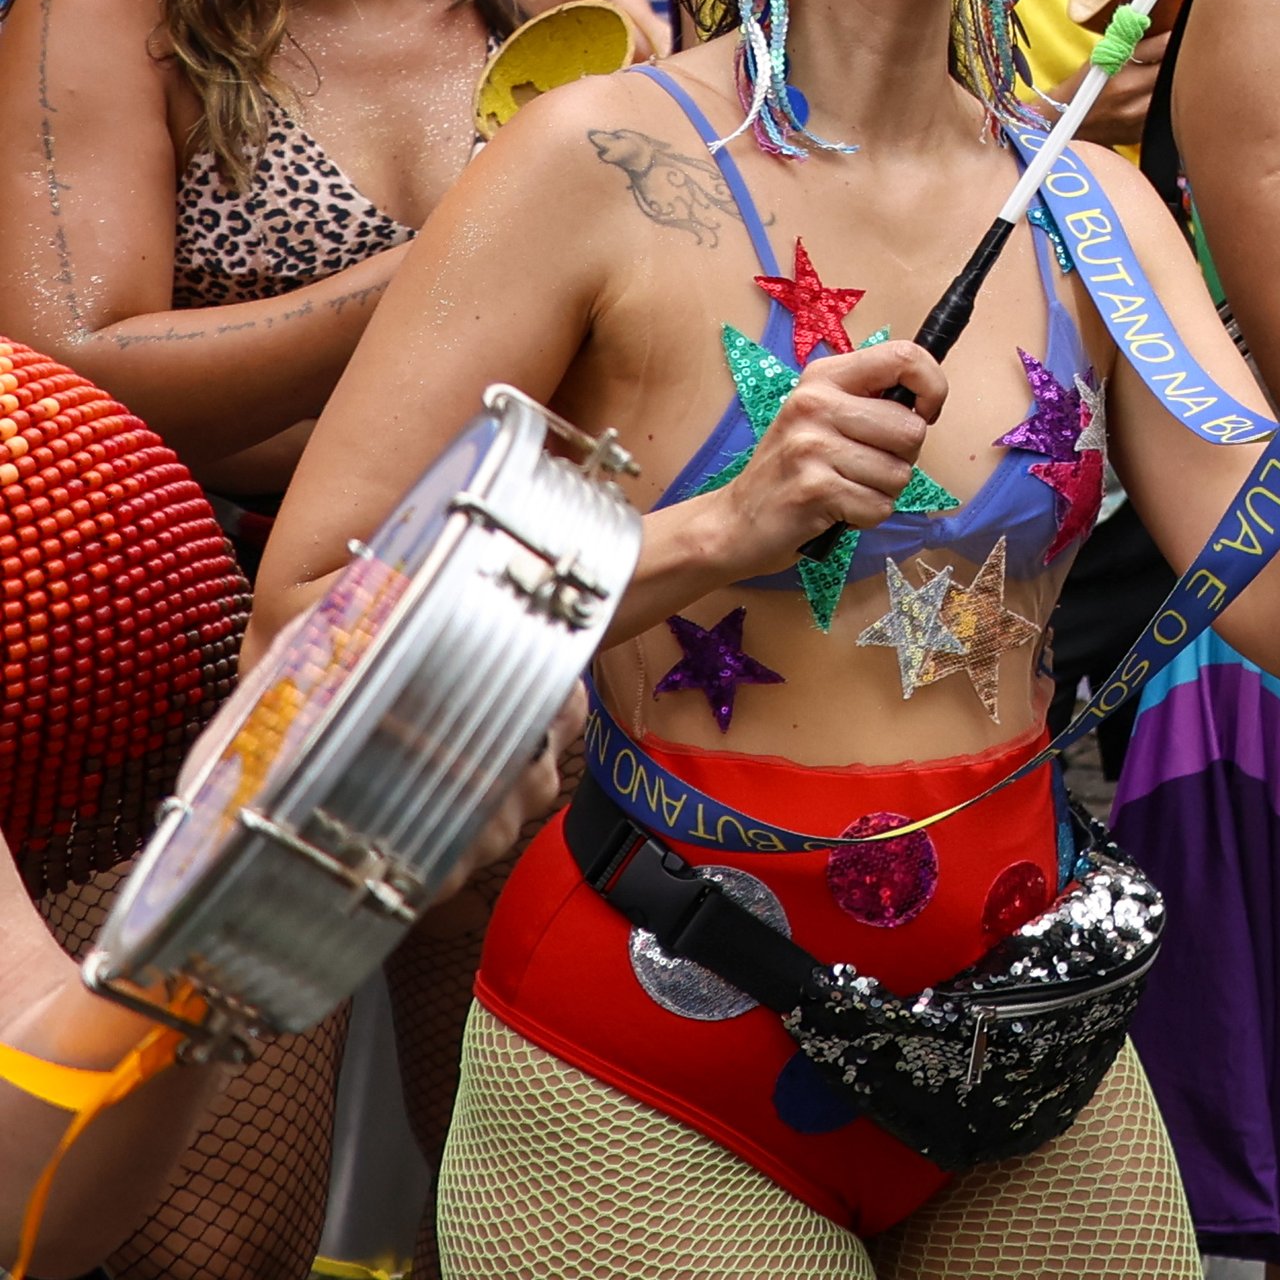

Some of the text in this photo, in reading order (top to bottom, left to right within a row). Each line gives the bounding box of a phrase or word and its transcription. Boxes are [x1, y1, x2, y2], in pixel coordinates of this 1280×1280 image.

[1065, 208, 1175, 363] BUTANO
[1151, 371, 1218, 417] NA
[1185, 567, 1229, 612] É
[1153, 609, 1188, 646] O
[612, 748, 787, 852] BUTANO
